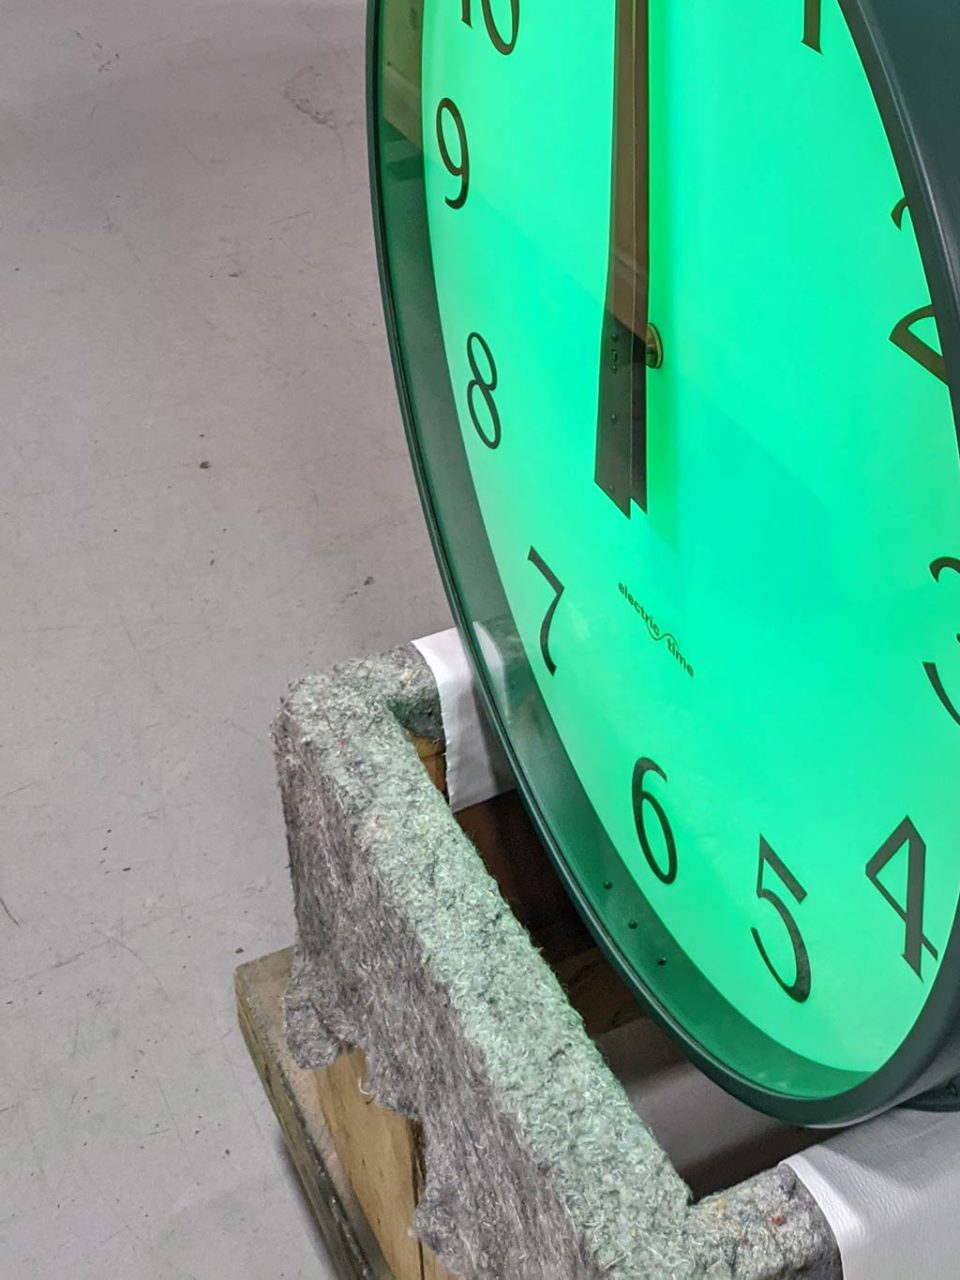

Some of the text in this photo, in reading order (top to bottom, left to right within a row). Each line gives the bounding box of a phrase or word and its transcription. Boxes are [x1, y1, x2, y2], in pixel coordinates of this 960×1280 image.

[436, 98, 469, 210] 9
[467, 331, 501, 450] 8
[527, 545, 565, 676] 7
[618, 581, 694, 678] electric time
[631, 757, 678, 885] 6
[750, 833, 811, 1004] 5
[865, 814, 938, 983] 4
